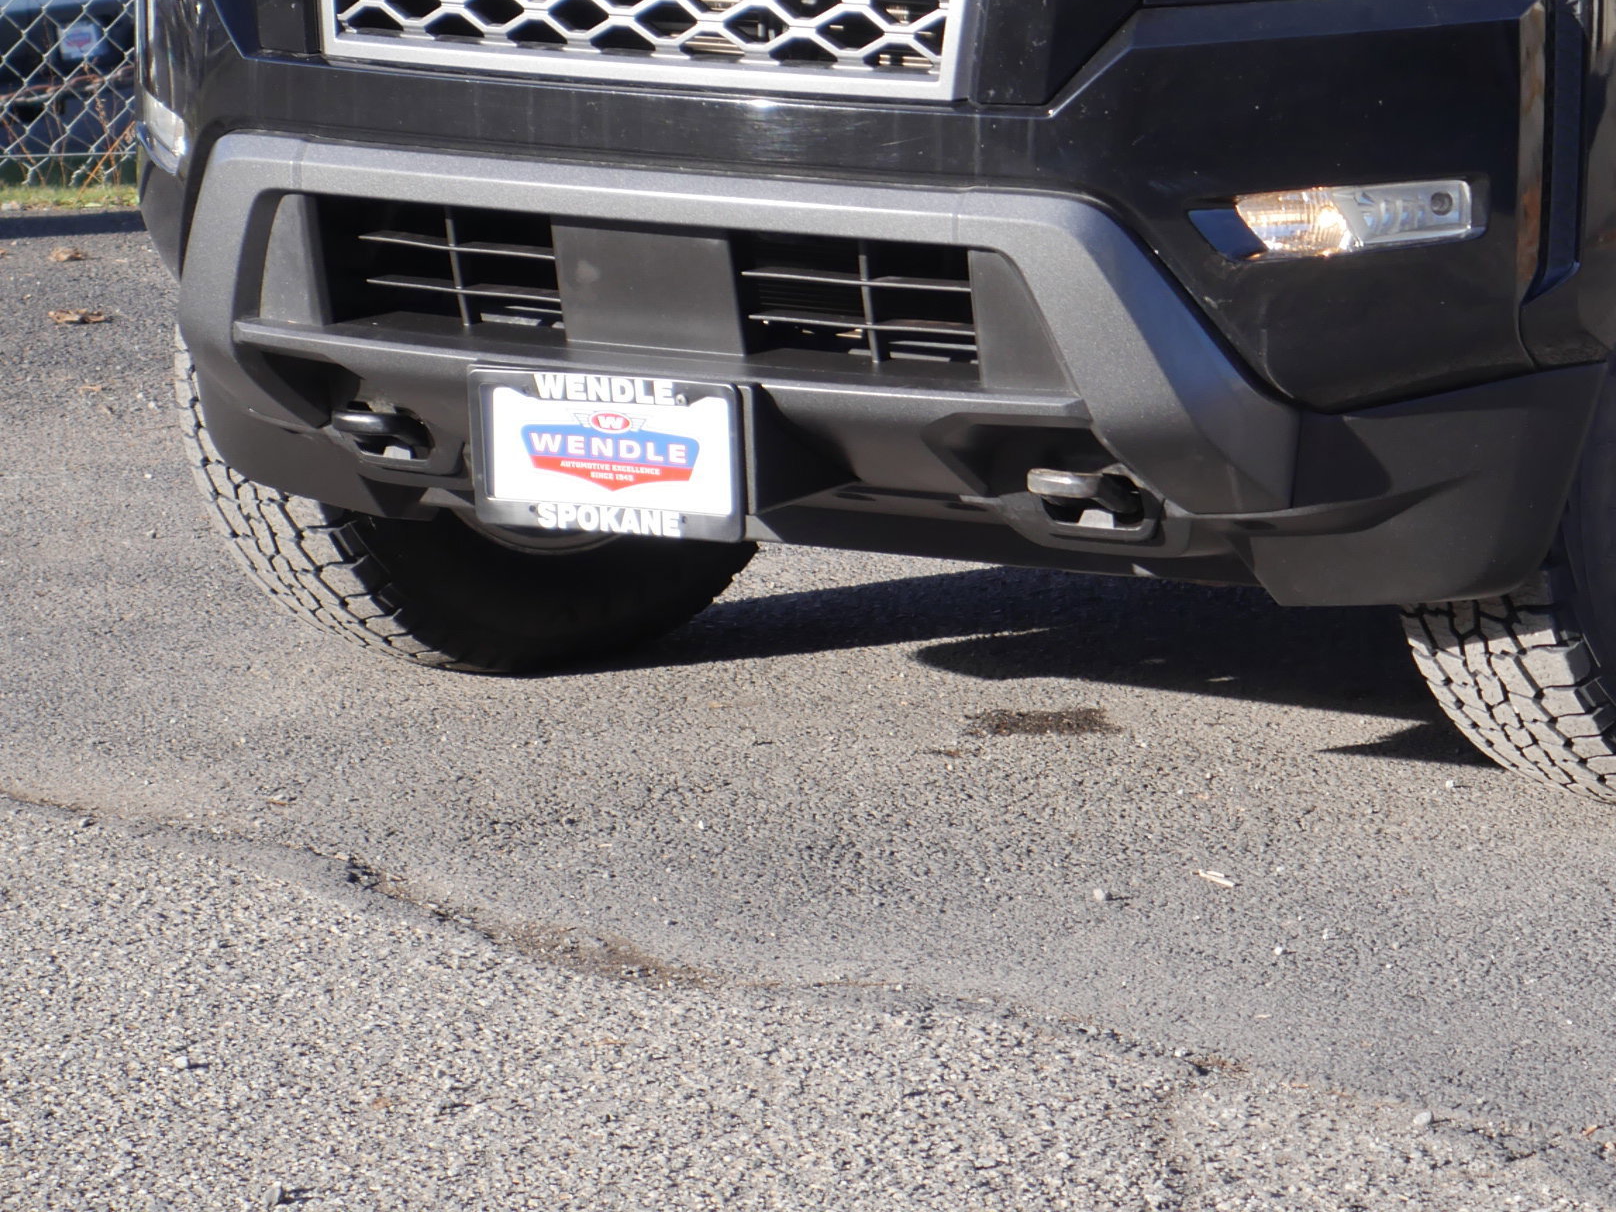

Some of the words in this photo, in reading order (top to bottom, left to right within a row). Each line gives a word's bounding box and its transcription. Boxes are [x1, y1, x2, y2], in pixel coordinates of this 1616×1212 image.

[534, 374, 675, 405] WENDLE
[531, 432, 687, 464] WENDLE
[560, 460, 610, 471] AUTOMOTIVE
[611, 464, 661, 475] EXCELLENCE
[537, 503, 681, 537] SPOKANE
